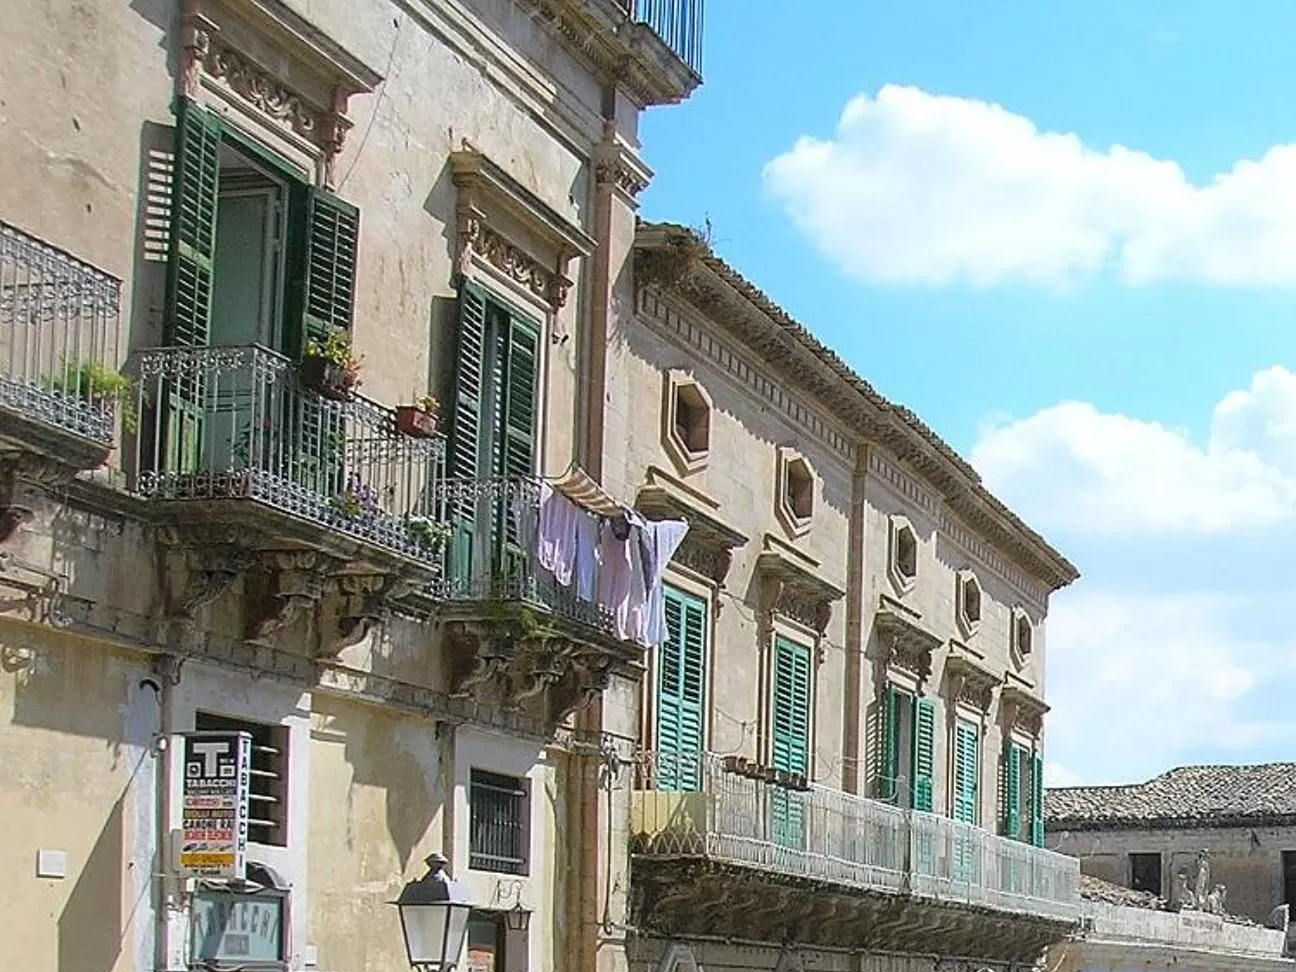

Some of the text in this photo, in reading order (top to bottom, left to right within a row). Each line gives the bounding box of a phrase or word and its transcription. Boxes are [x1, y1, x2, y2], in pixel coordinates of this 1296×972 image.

[193, 742, 229, 778] T
[186, 778, 237, 788] TABACCHI
[238, 740, 249, 868] TABACCHI
